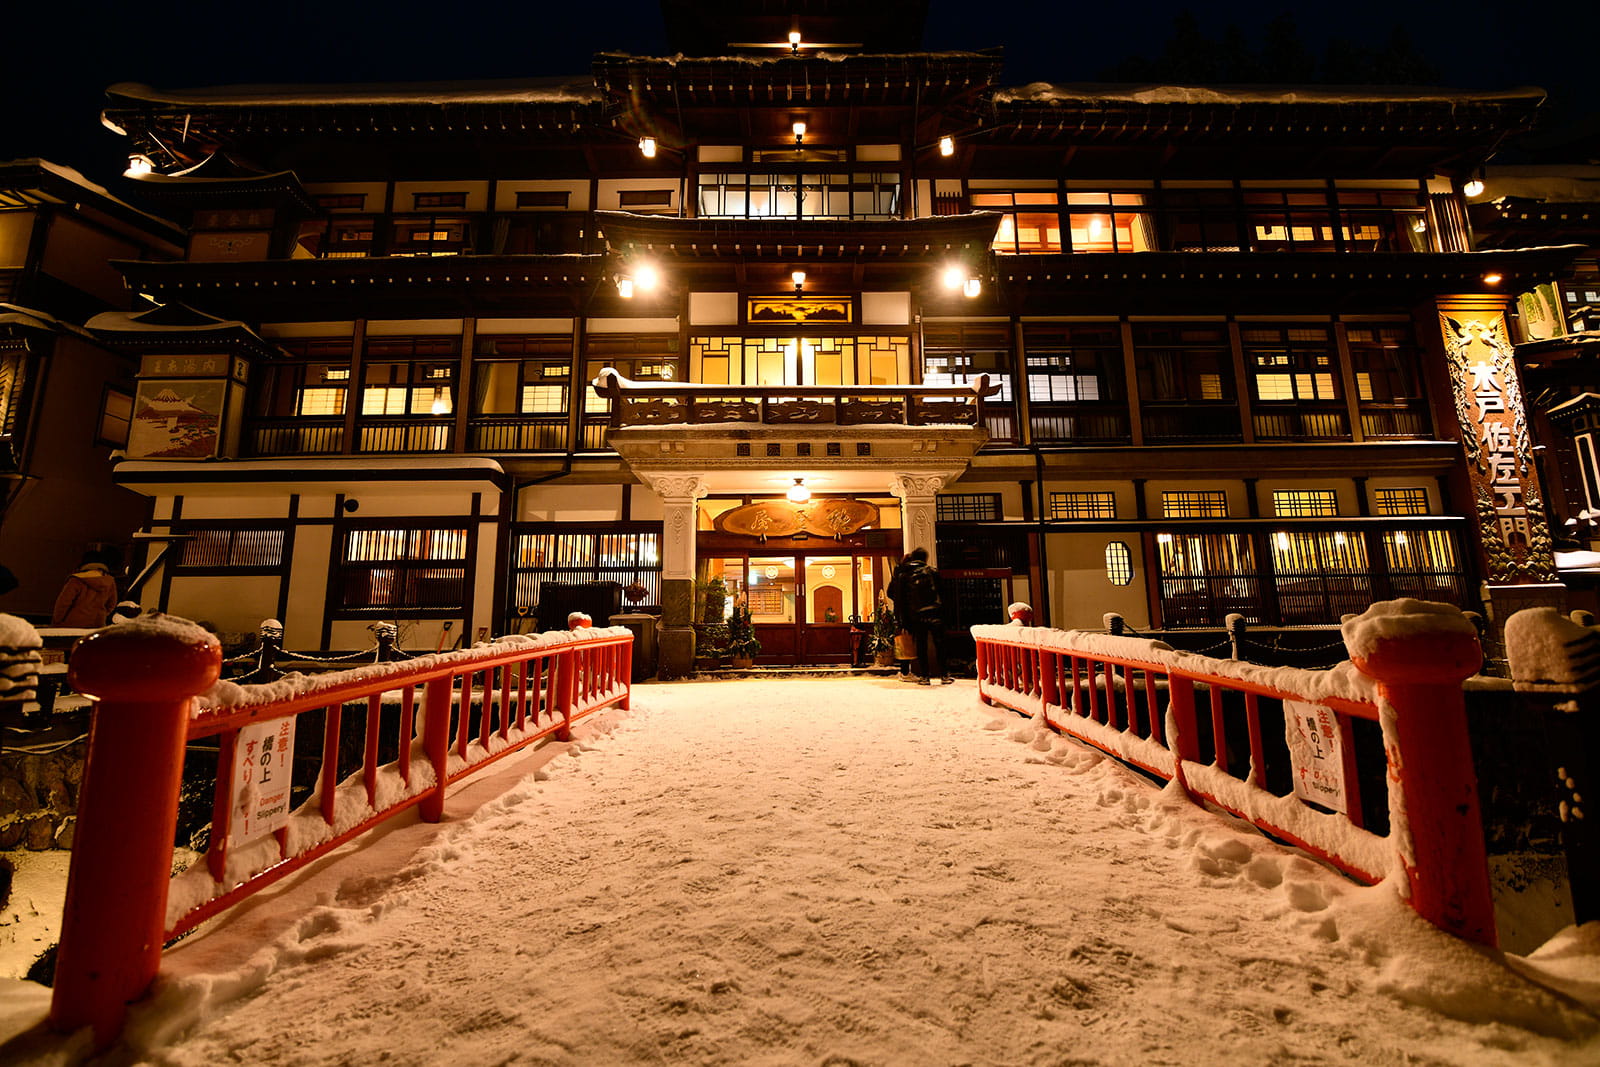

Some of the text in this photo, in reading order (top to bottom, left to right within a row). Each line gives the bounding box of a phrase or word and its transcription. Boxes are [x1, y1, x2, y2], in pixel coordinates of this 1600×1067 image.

[259, 735, 274, 784] 橋の上
[1306, 716, 1325, 760] 橋の上
[260, 792, 284, 807] Danger
